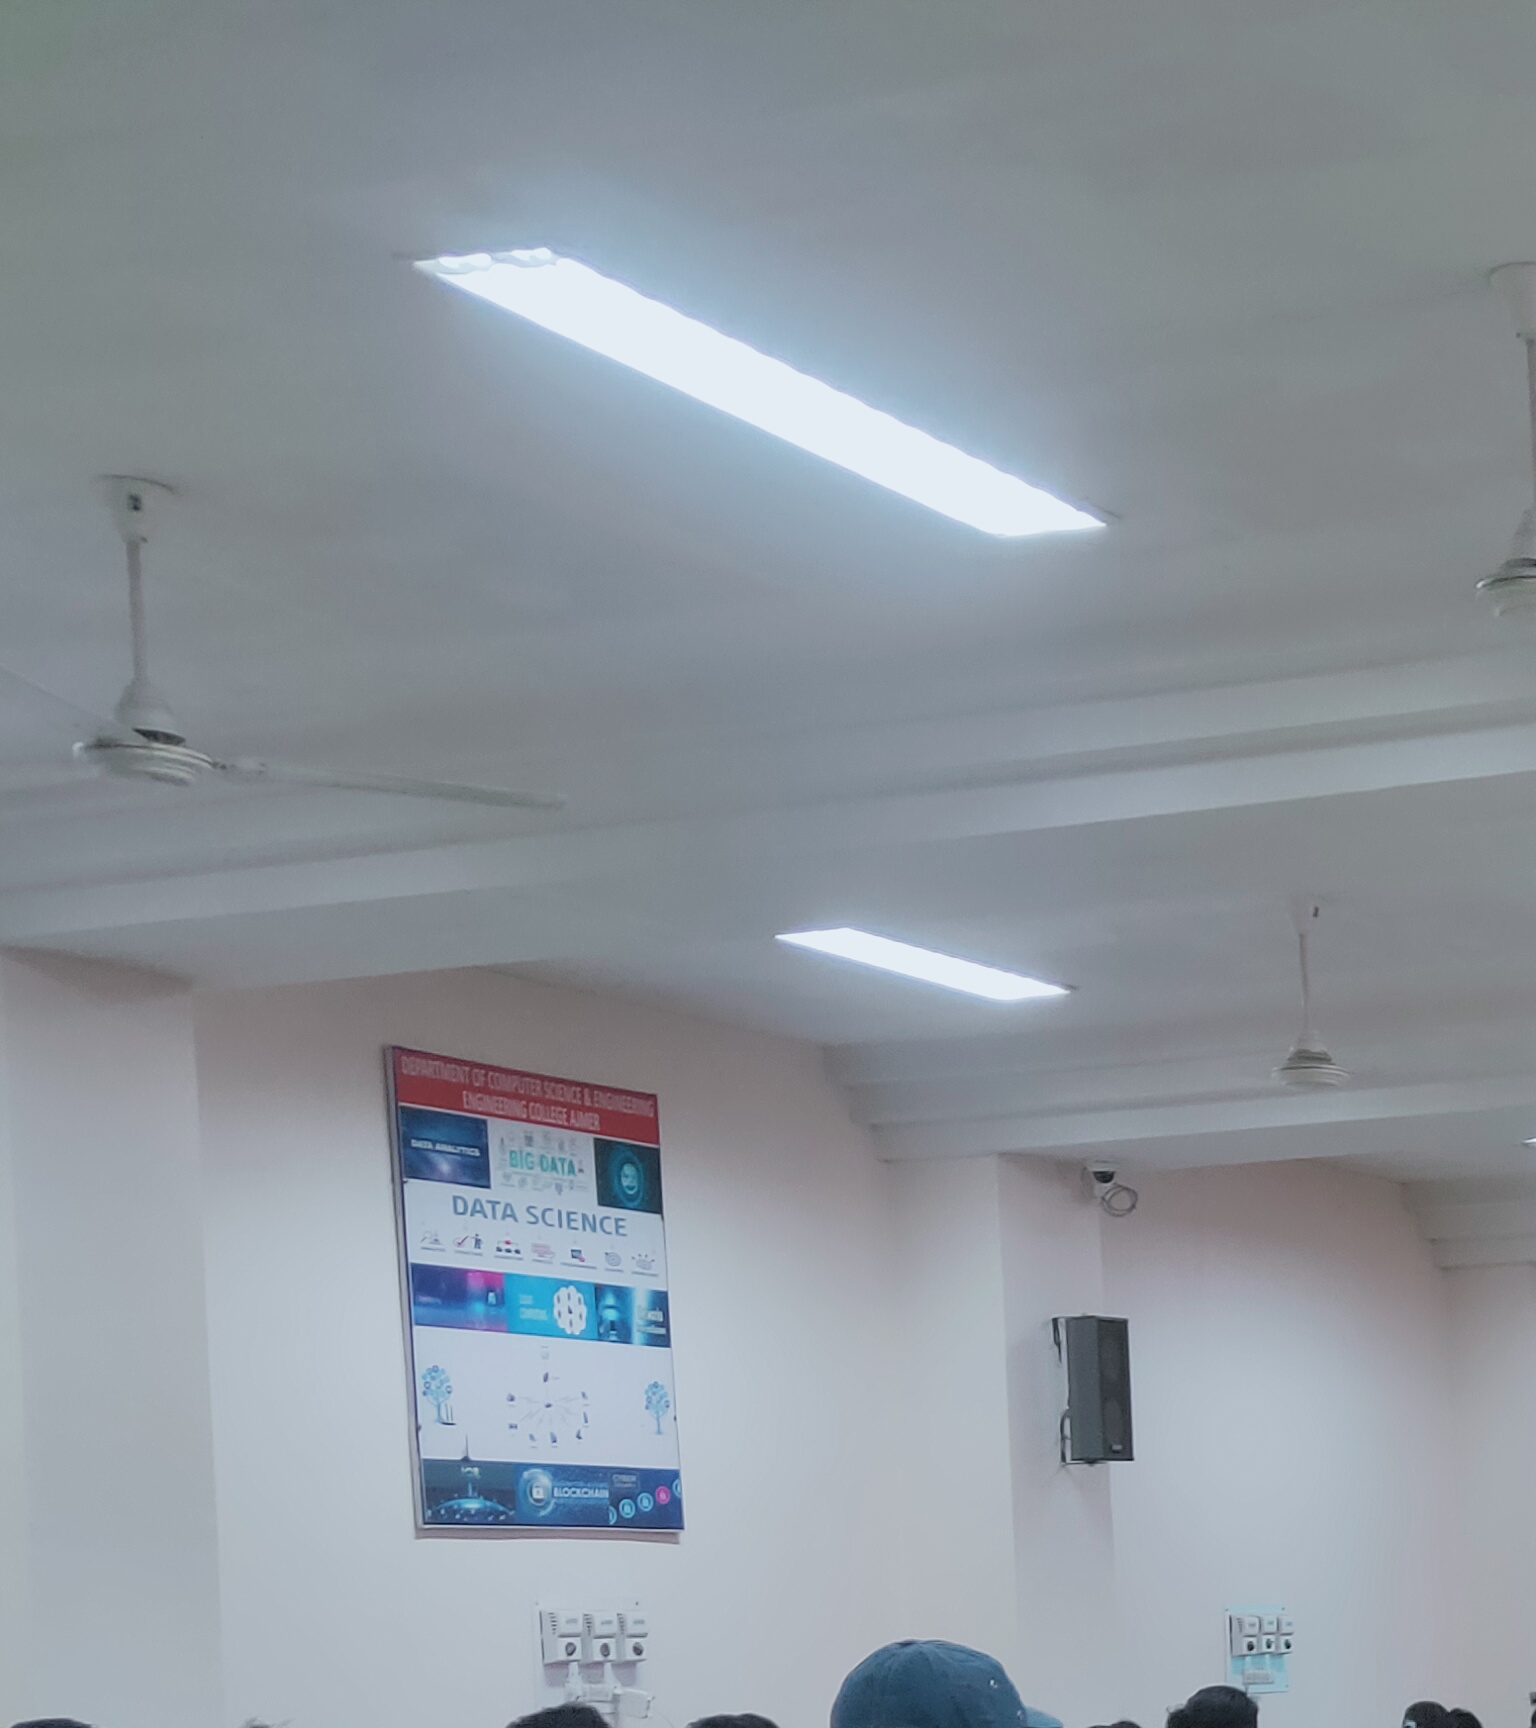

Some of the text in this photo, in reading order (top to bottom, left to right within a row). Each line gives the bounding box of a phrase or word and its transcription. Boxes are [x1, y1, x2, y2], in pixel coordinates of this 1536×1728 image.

[401, 1056, 655, 1118] DEPARTMENT OF COMPUTER SCIENCE & ENGINEERING
[463, 1090, 527, 1119] ENGINEERING
[529, 1101, 569, 1126] COLLEGE
[509, 1149, 577, 1177] BIG DATA
[452, 1195, 628, 1237] DATA SCIENCE
